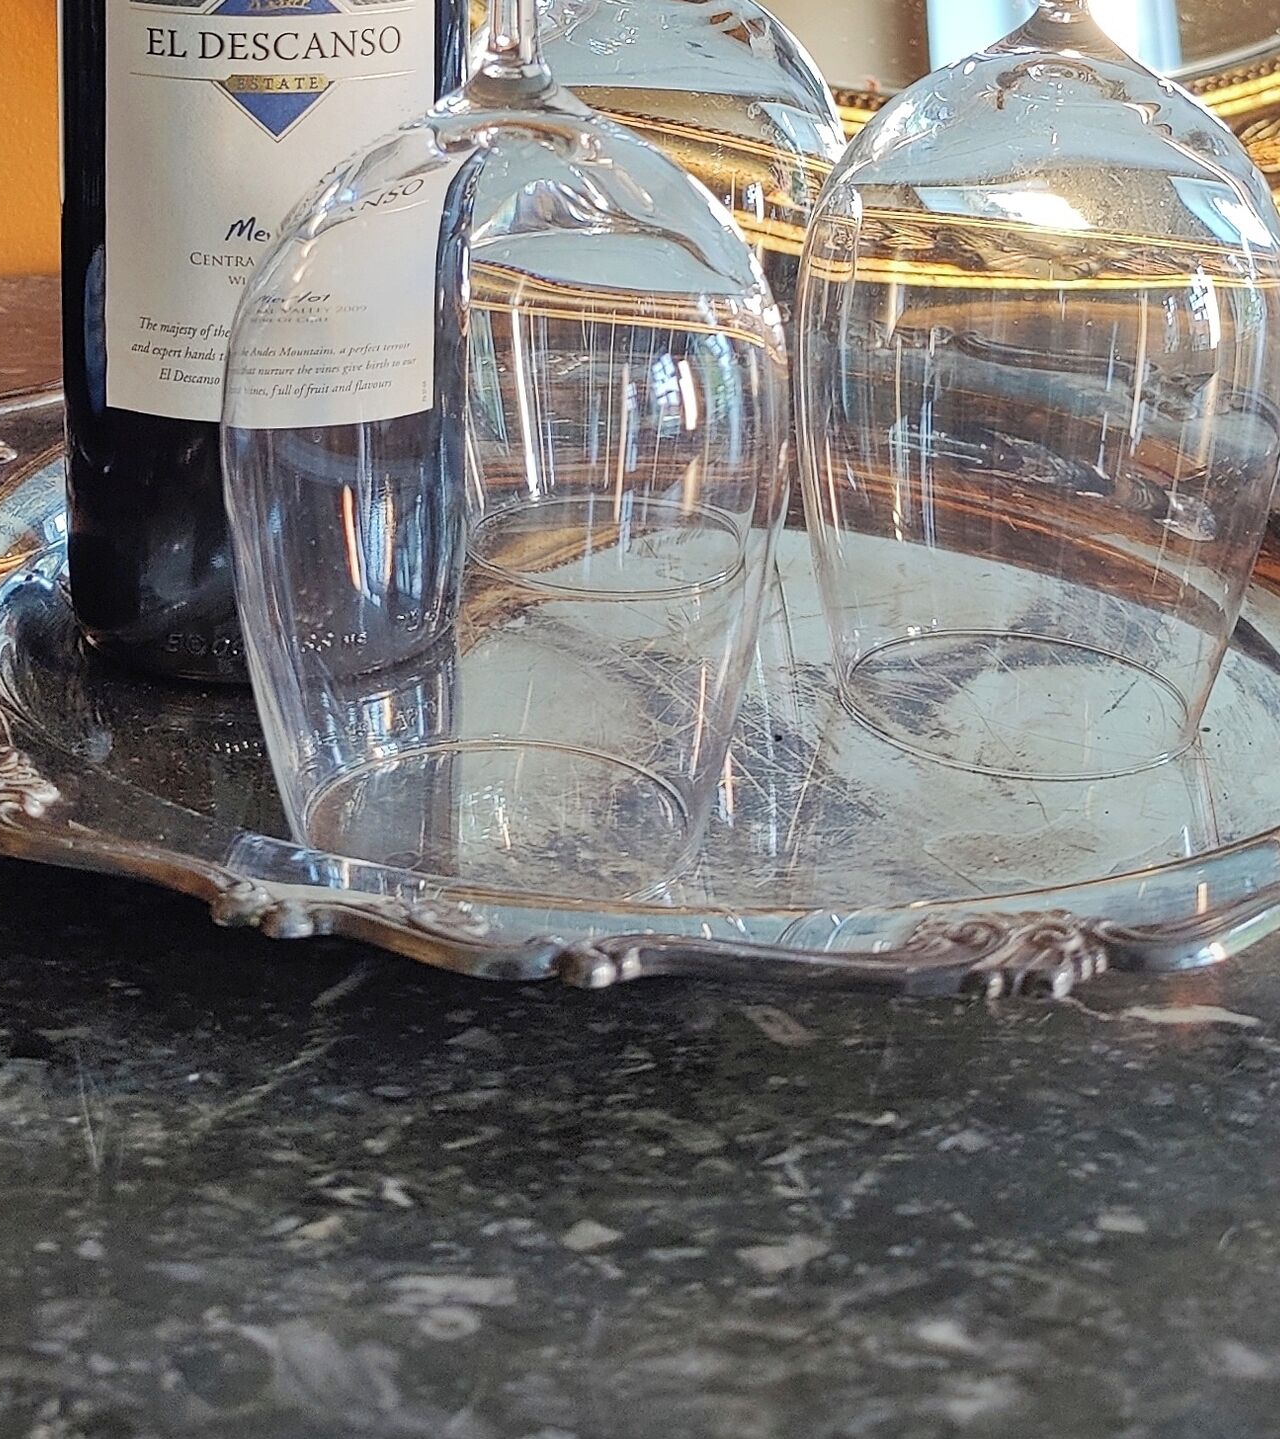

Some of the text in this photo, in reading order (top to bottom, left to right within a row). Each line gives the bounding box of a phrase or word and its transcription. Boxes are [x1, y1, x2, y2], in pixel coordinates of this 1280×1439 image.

[146, 25, 402, 61] EL DESCANSO
[237, 76, 319, 90] ESTATE
[139, 316, 230, 340] The majesty of the
[131, 340, 151, 353] and
[152, 346, 182, 360] expert
[184, 346, 216, 361] hands
[347, 342, 381, 356] perfect
[159, 367, 221, 385] El Descanso
[258, 367, 295, 376] nurture
[297, 364, 313, 375] the
[315, 365, 340, 374] vines
[341, 364, 363, 375] give
[365, 358, 391, 370] birth
[391, 359, 401, 367] to
[270, 384, 292, 399] full
[304, 383, 330, 398] fruit
[331, 380, 354, 393] and
[352, 379, 393, 395] flavours
